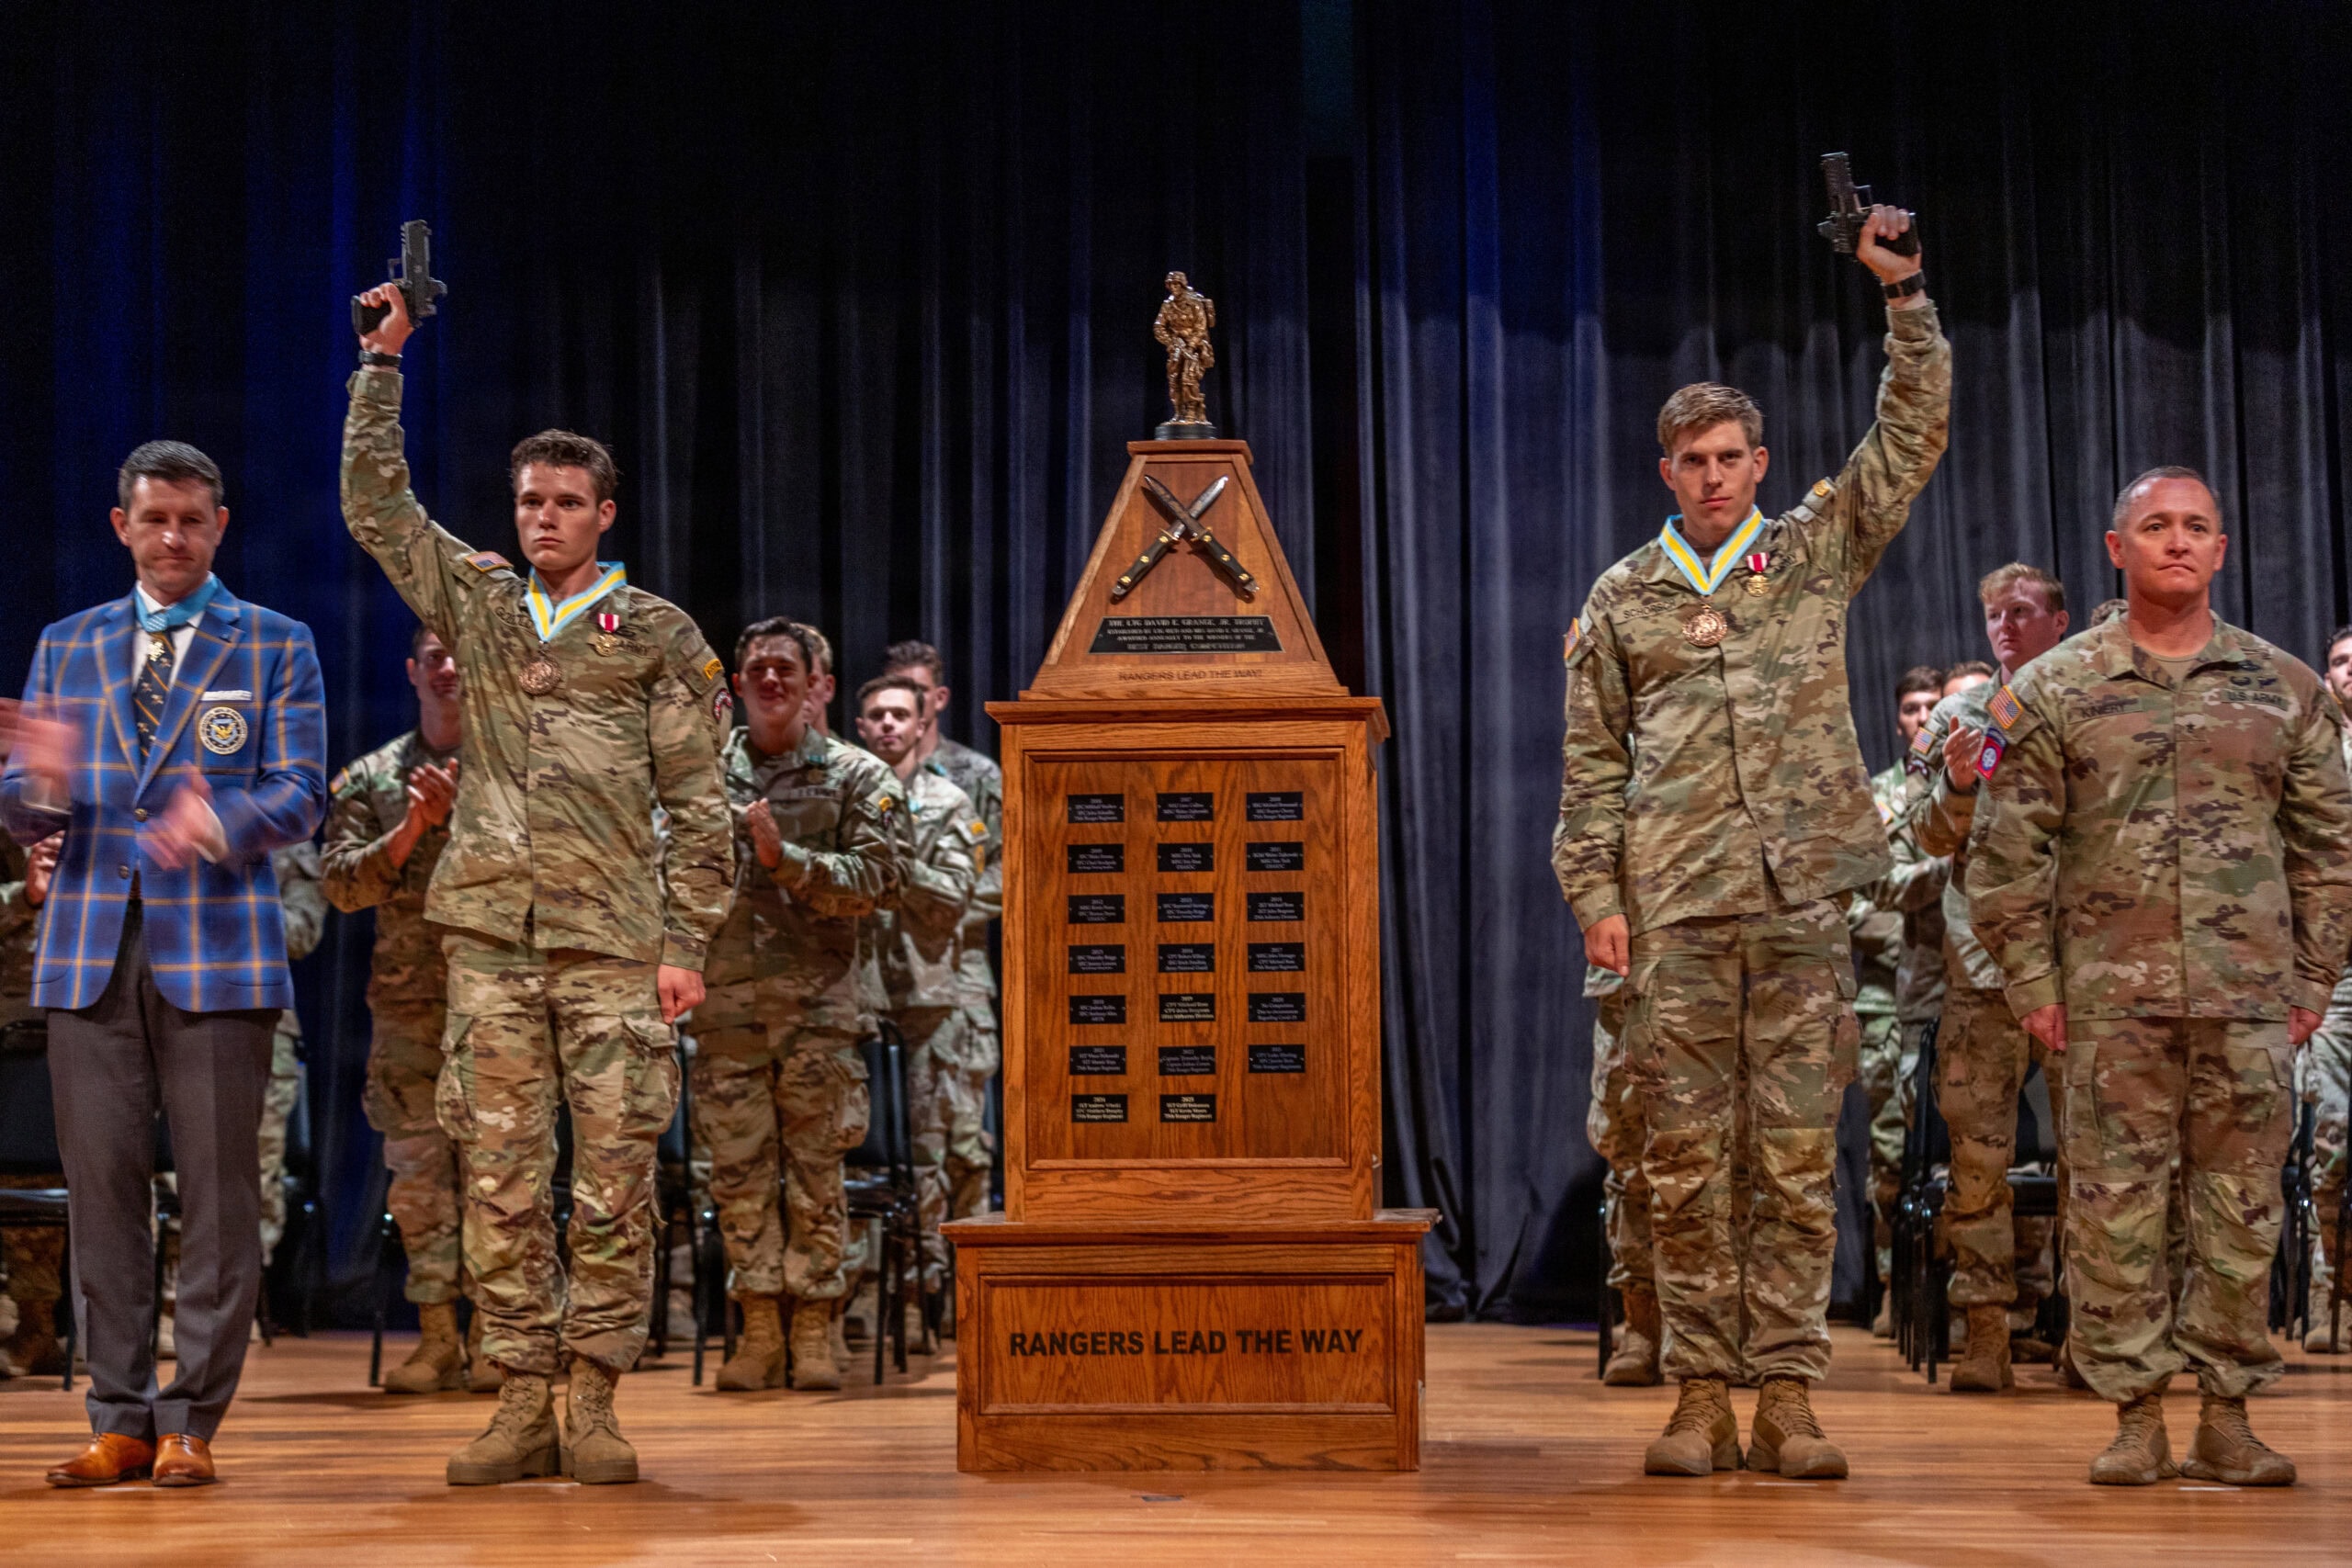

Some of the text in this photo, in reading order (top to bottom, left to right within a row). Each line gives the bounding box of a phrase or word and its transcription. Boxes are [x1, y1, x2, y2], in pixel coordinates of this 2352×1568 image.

[1118, 671, 1175, 681] RANGERS
[1176, 671, 1206, 680] LEAD
[1209, 670, 1231, 679] THE
[2253, 692, 2283, 705] ARMY
[1010, 1328, 1363, 1357] RANGERS LEAD THE WAY
